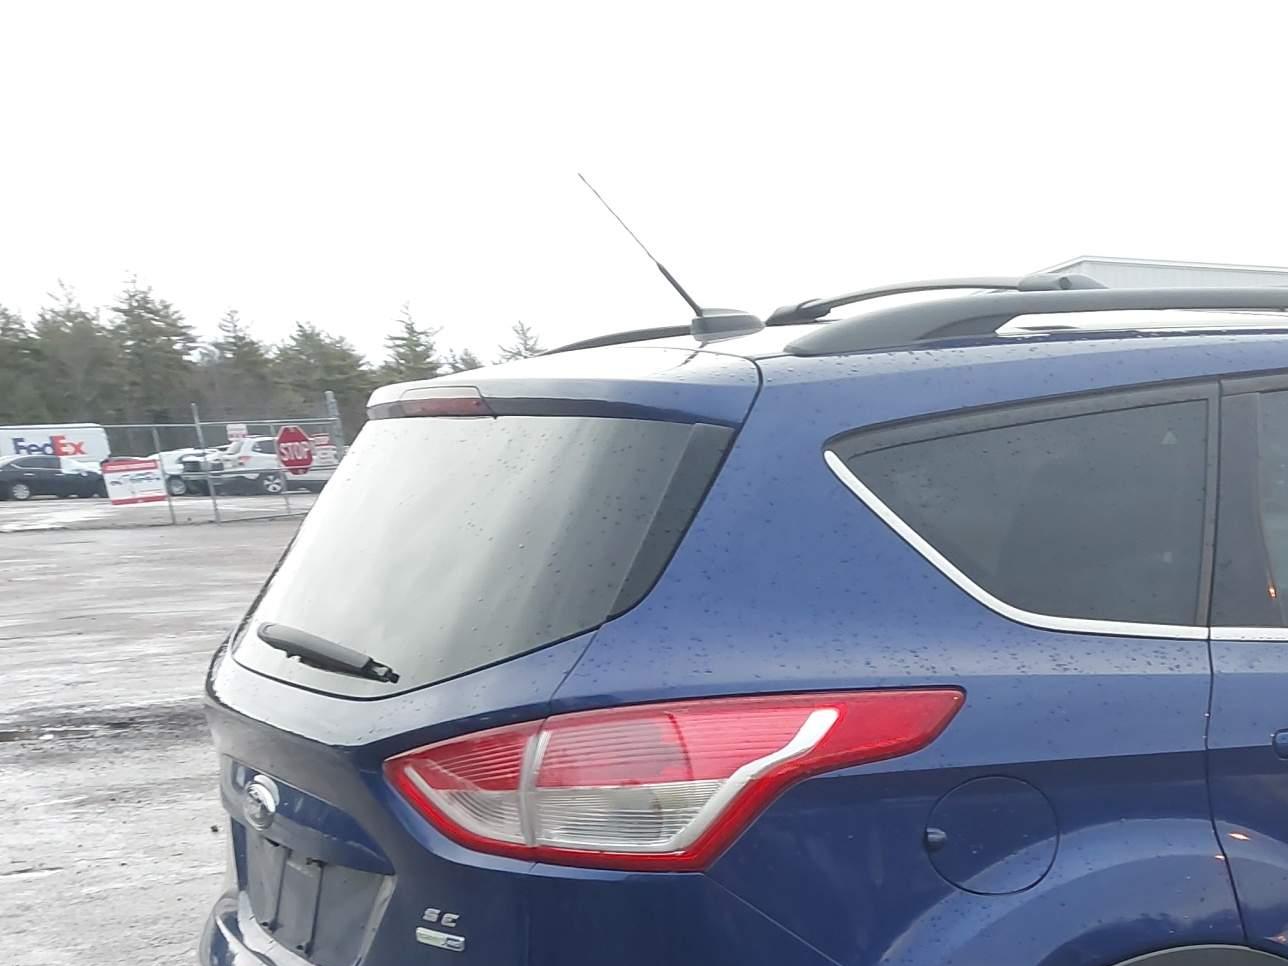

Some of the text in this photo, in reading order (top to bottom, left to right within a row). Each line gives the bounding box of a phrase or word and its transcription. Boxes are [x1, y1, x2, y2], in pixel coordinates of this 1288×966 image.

[11, 434, 87, 456] FedEx
[279, 441, 311, 461] STOP
[422, 908, 460, 928] SE
